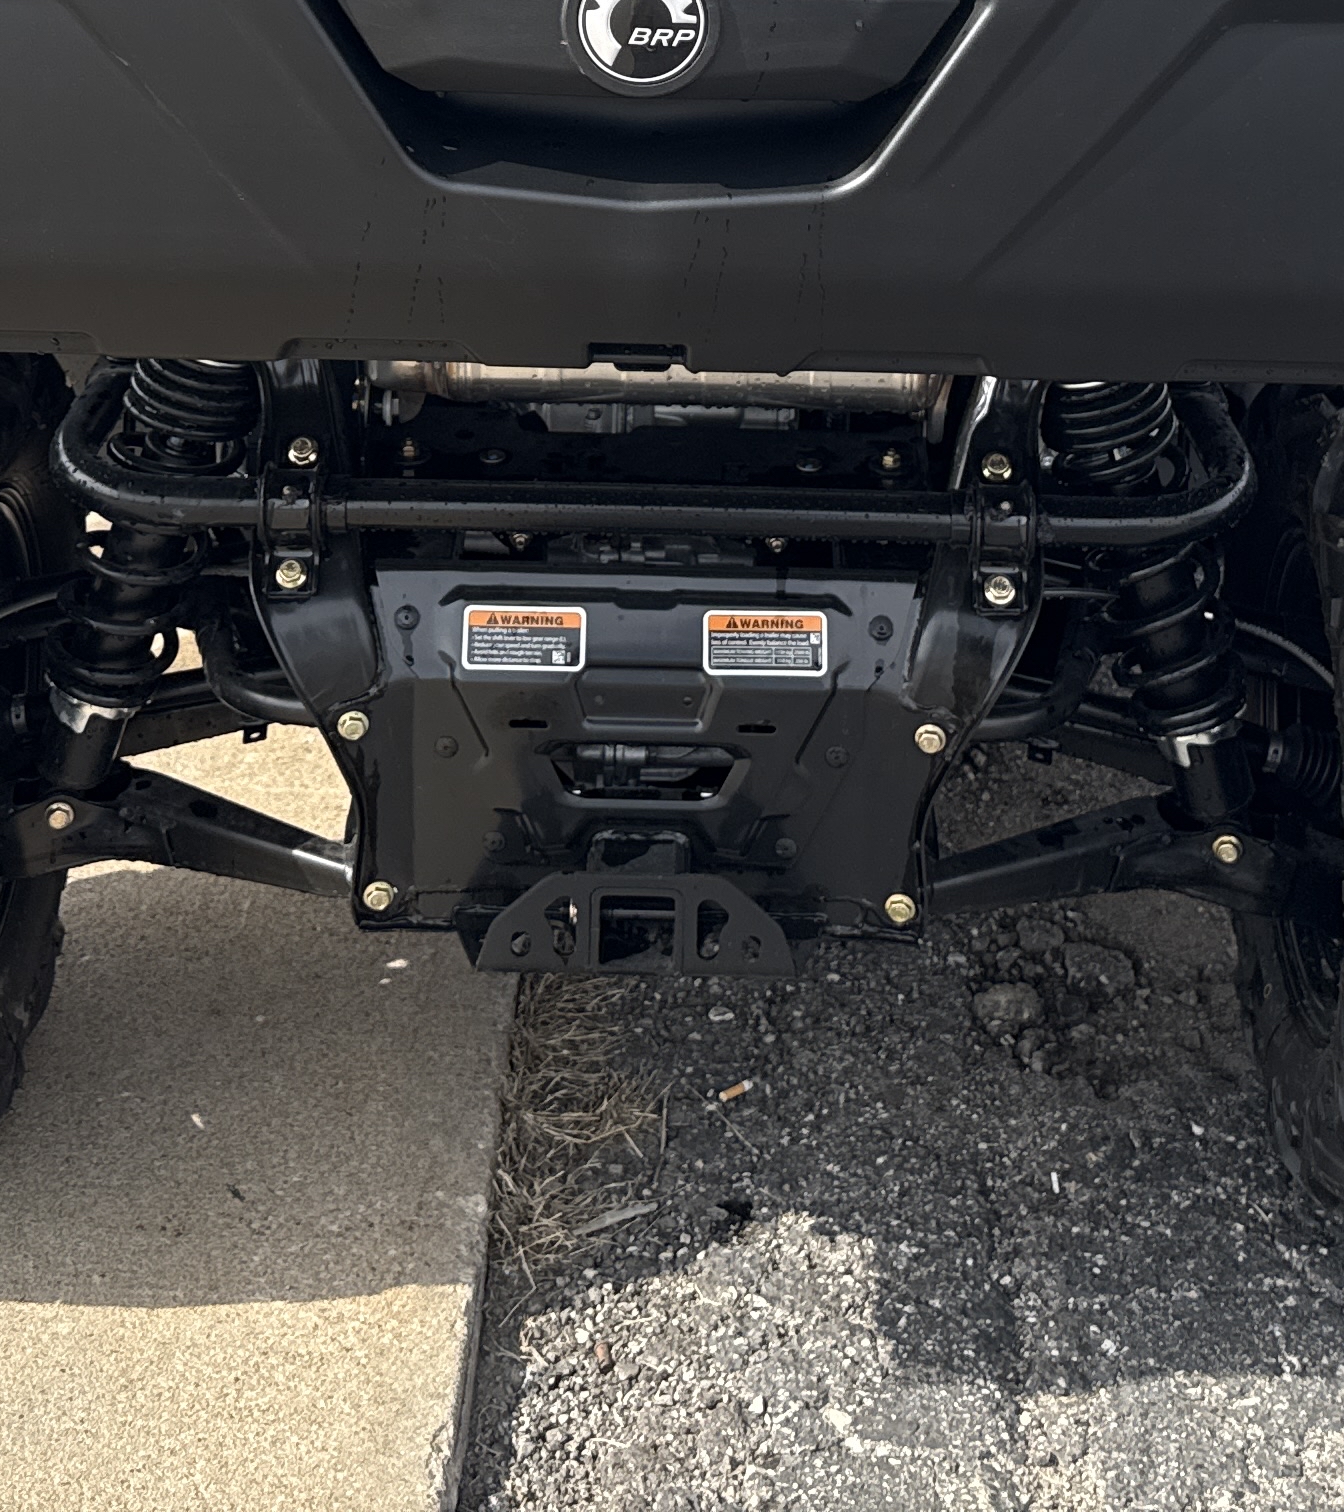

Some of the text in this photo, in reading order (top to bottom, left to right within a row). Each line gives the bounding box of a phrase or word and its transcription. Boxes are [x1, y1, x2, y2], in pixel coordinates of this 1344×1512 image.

[628, 27, 696, 47] BRP
[500, 614, 564, 626] WARNING
[739, 618, 804, 629] WARNING
